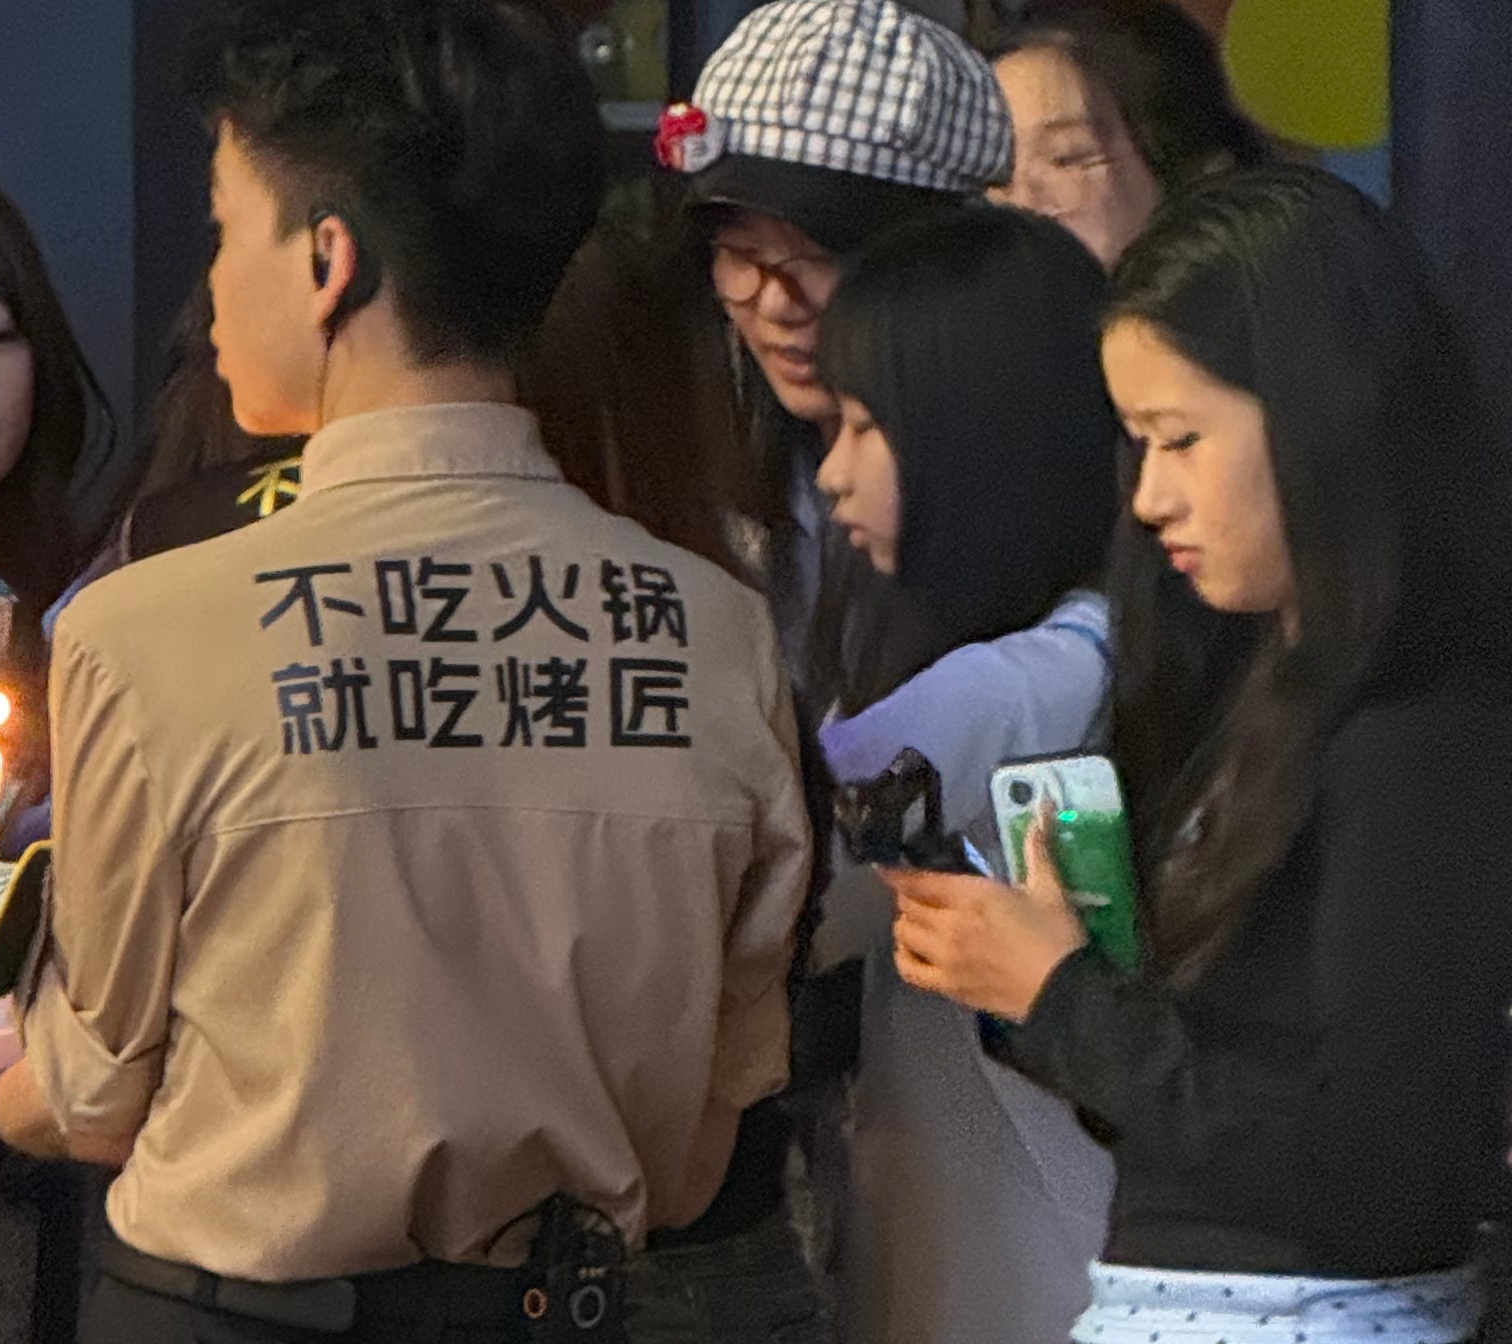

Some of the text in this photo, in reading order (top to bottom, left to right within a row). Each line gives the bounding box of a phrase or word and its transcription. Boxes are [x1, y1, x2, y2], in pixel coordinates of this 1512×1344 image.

[255, 557, 689, 648] 不吃火锅
[272, 657, 692, 755] 就吃烤匠
